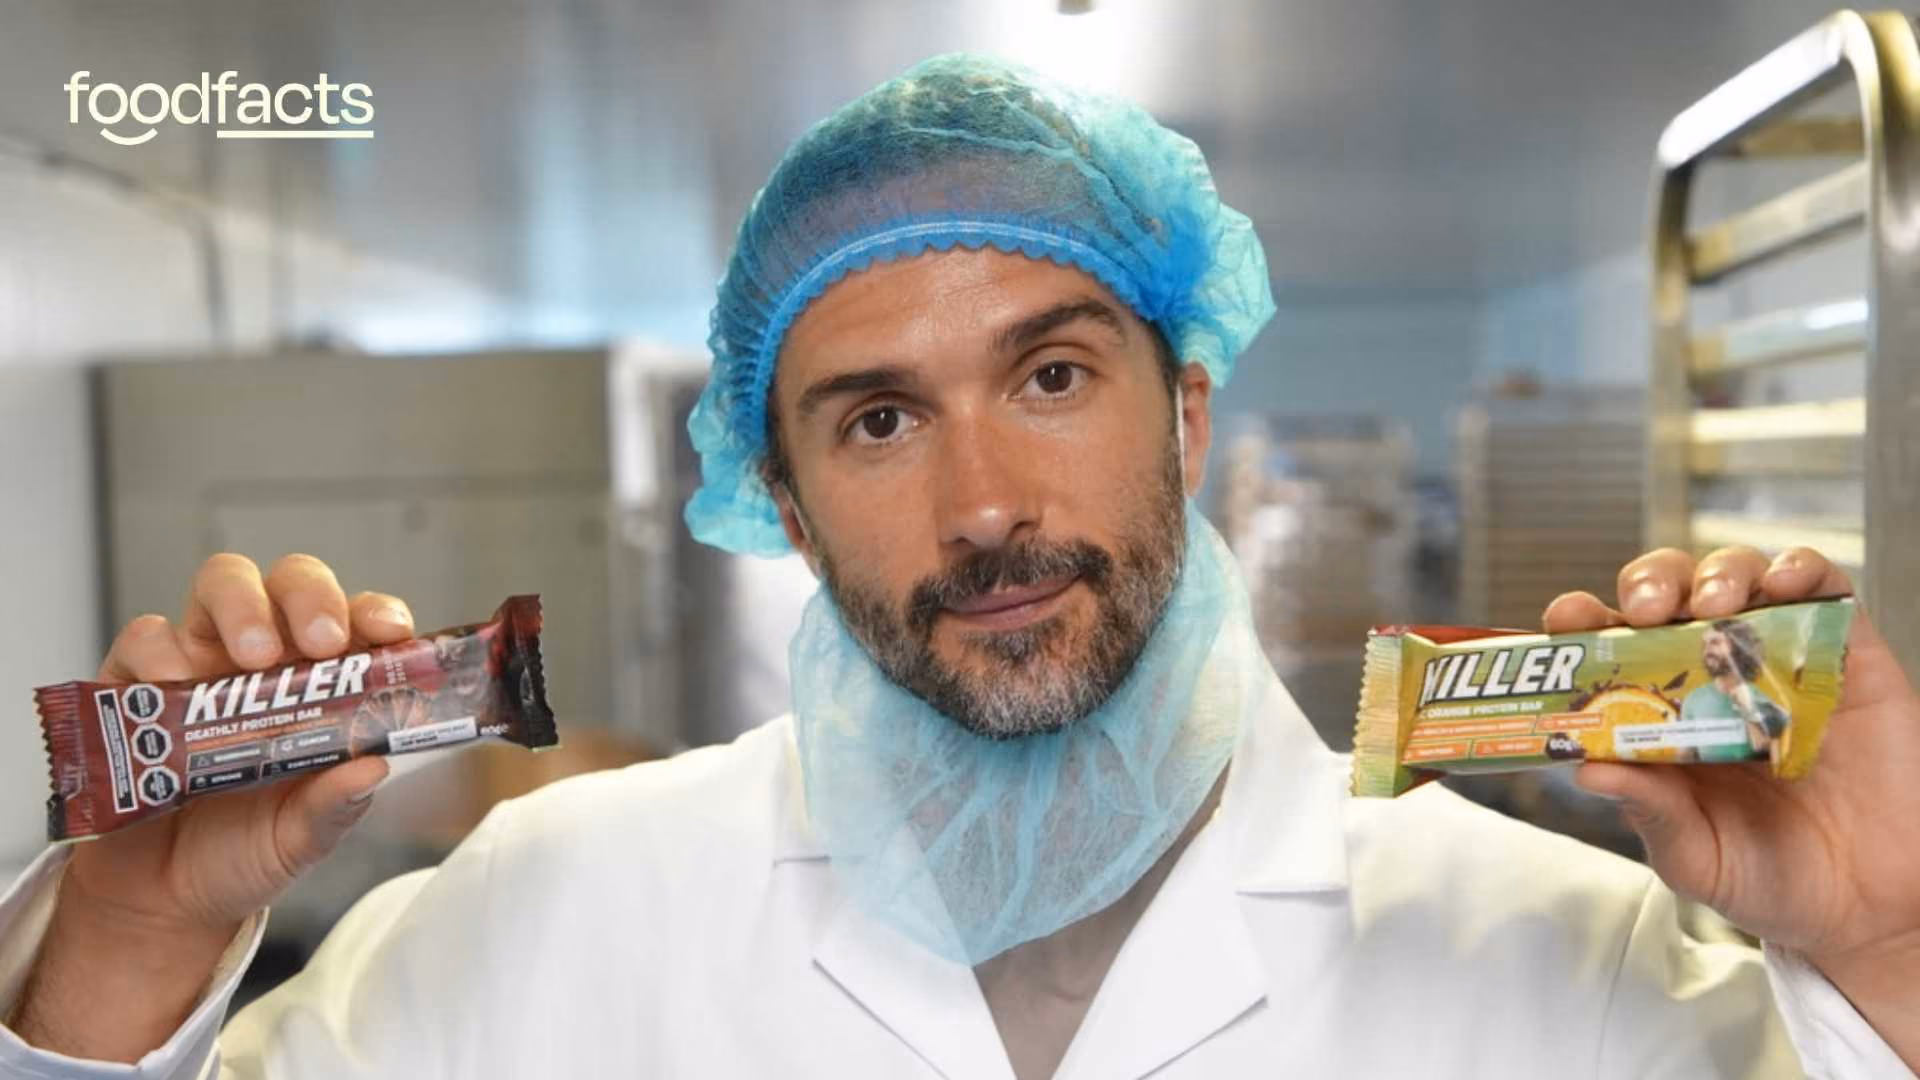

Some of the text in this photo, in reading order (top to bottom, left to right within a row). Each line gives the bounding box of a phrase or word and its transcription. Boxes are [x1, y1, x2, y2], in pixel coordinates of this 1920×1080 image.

[183, 653, 372, 726] KILLER
[185, 723, 239, 742] DEATHLY
[241, 712, 294, 731] PROTEIN
[296, 706, 322, 722] BAR
